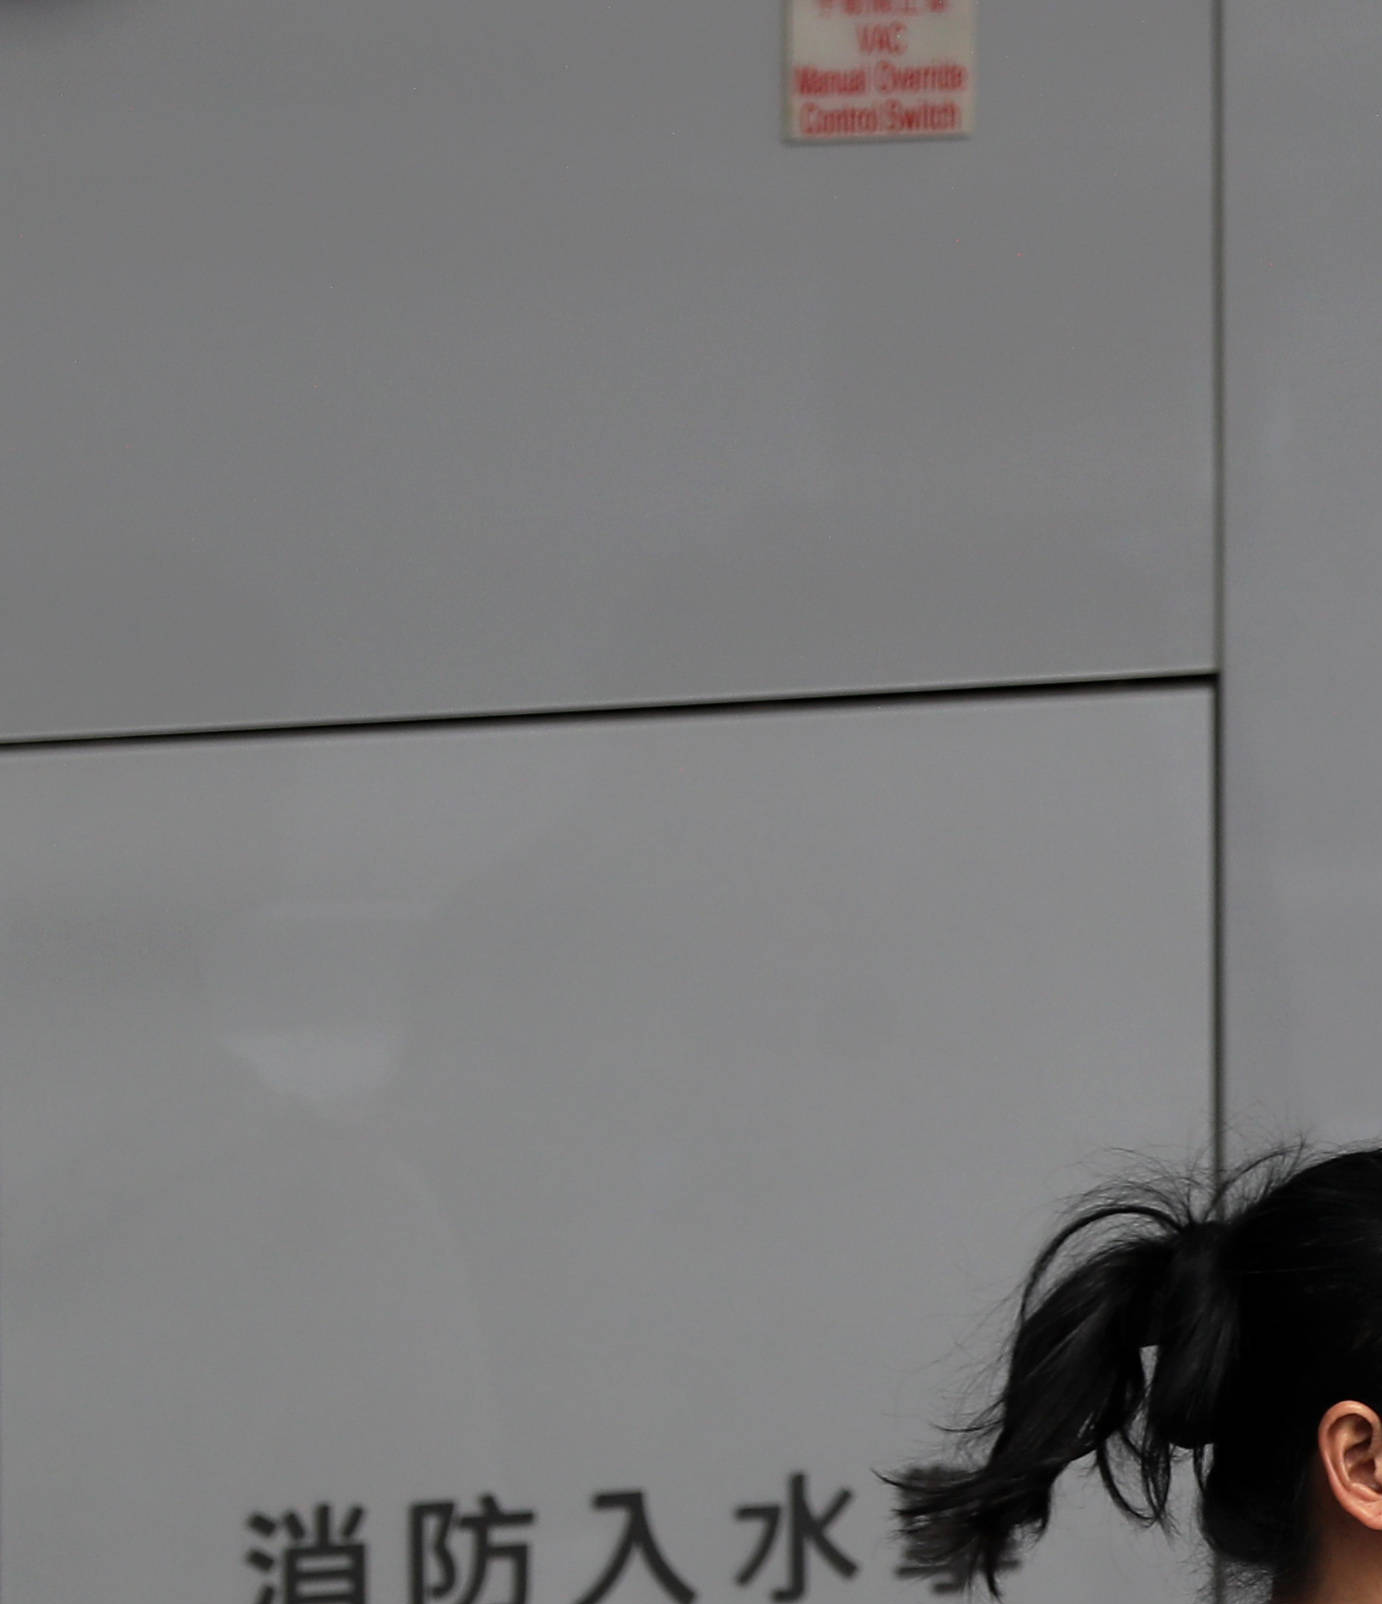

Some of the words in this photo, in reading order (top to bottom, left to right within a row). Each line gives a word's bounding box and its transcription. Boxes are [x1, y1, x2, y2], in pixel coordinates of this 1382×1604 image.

[795, 65, 867, 95] Manual
[874, 60, 967, 93] Override
[801, 101, 877, 134] Control
[880, 98, 960, 131] Switch
